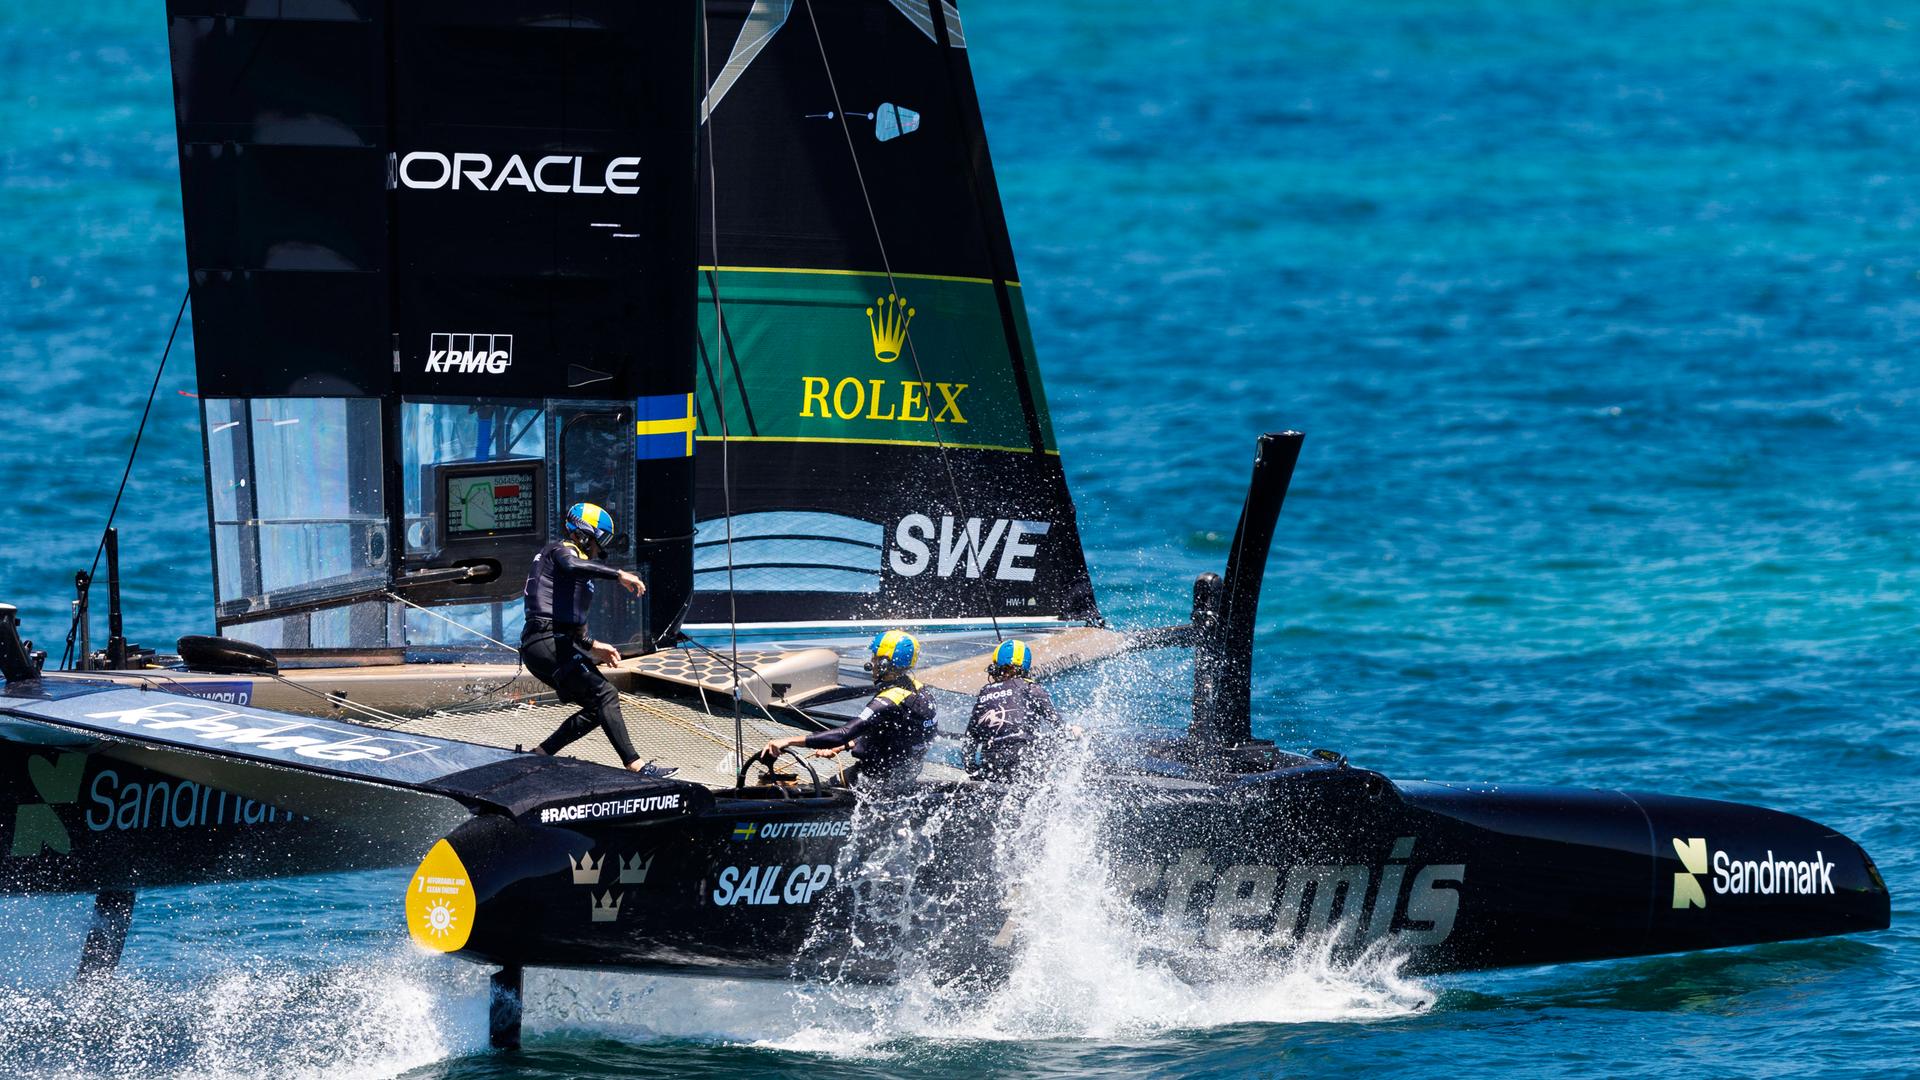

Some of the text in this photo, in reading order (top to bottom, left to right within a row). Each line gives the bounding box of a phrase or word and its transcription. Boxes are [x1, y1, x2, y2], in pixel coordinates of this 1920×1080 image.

[399, 151, 642, 194] ORACLE
[424, 350, 509, 374] KPMG
[799, 376, 969, 423] ROLEX
[889, 513, 1051, 582] SWE
[980, 689, 1013, 703] GROSS
[84, 707, 391, 762] KPMG
[86, 770, 310, 832] Sandma
[540, 794, 680, 823] #RACEFORTHEFUTURE
[760, 821, 850, 839] OUTTERIDGE
[417, 876, 425, 893] 7
[994, 837, 1466, 949] rtemis
[1713, 850, 1836, 894] Sandmark
